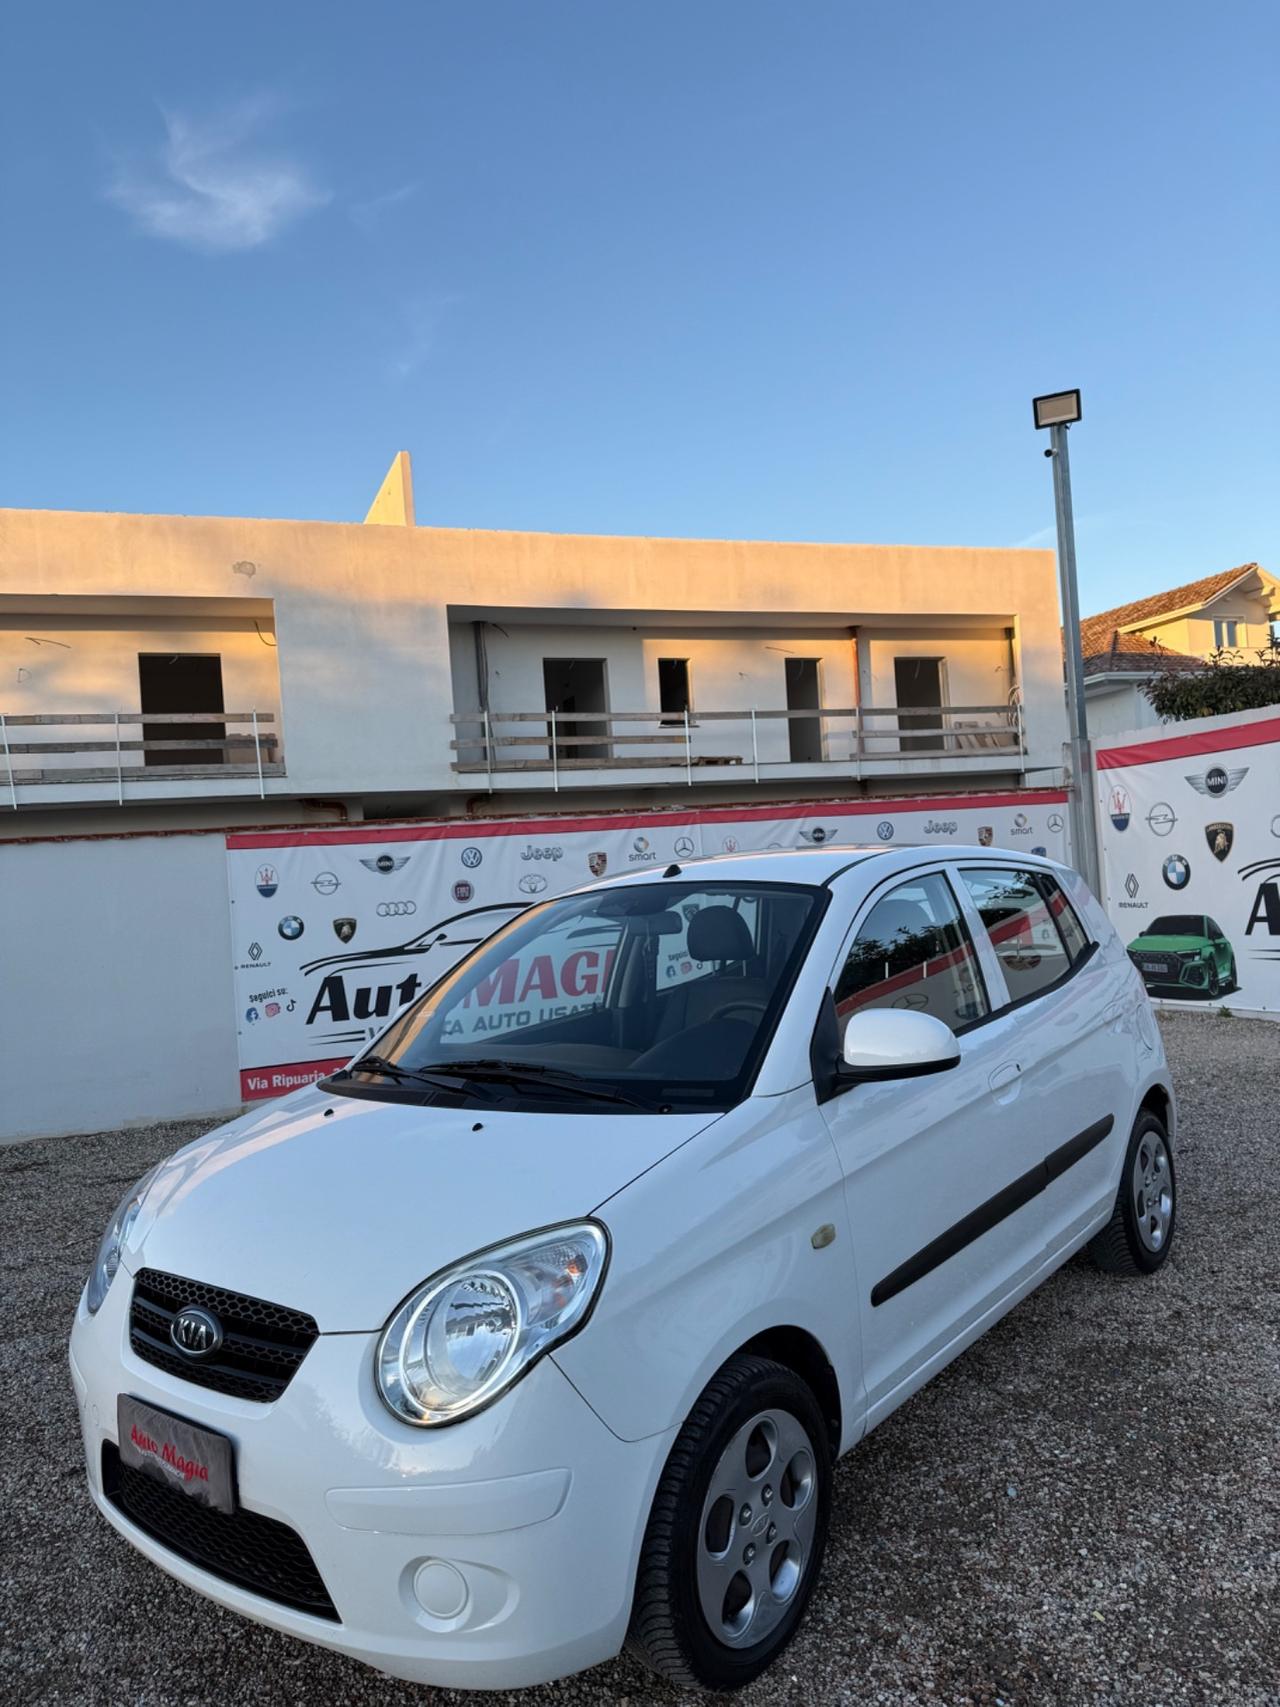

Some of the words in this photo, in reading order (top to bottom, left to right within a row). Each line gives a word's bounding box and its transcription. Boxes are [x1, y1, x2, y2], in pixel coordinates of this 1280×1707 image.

[1207, 776, 1226, 786] MINI
[923, 820, 958, 835] Jeep
[1010, 827, 1034, 836] smart
[520, 845, 564, 862] Jeep
[628, 851, 657, 862] smart
[1118, 901, 1149, 909] RENAULT
[306, 973, 428, 1025] Aut
[472, 1010, 531, 1033] AUTO
[247, 1077, 269, 1091] Via
[177, 1318, 207, 1349] KIA
[130, 1423, 159, 1454] Auto
[161, 1441, 209, 1482] Magia
